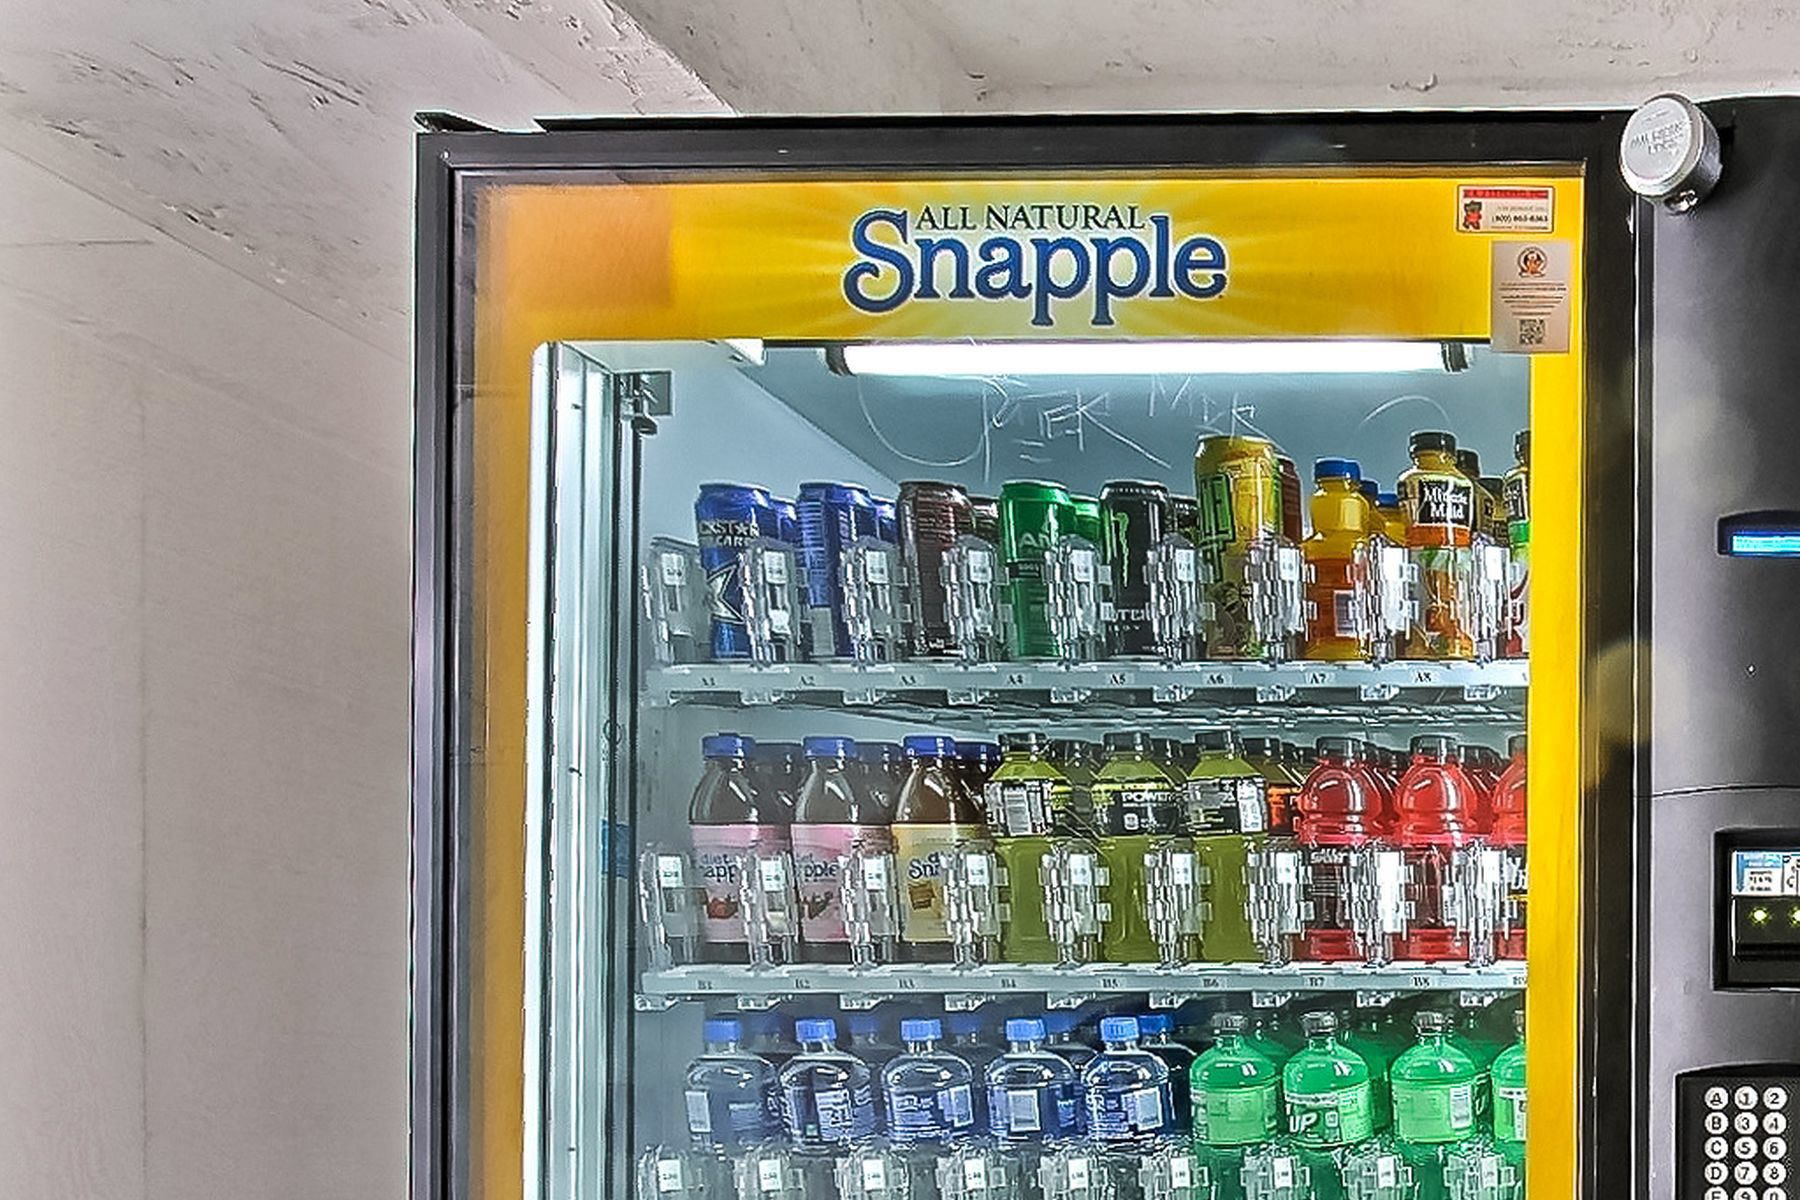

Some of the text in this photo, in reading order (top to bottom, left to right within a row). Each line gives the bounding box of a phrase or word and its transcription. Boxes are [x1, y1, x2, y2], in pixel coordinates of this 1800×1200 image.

[915, 204, 1147, 232] ALL NATURAL
[842, 210, 1228, 327] Snapple
[1711, 1093, 1779, 1105] A 1 2
[1711, 1118, 1722, 1129] B
[1742, 1118, 1751, 1129] 3
[1711, 1142, 1779, 1154] C 5 6
[1711, 1167, 1779, 1179] D 7 8
